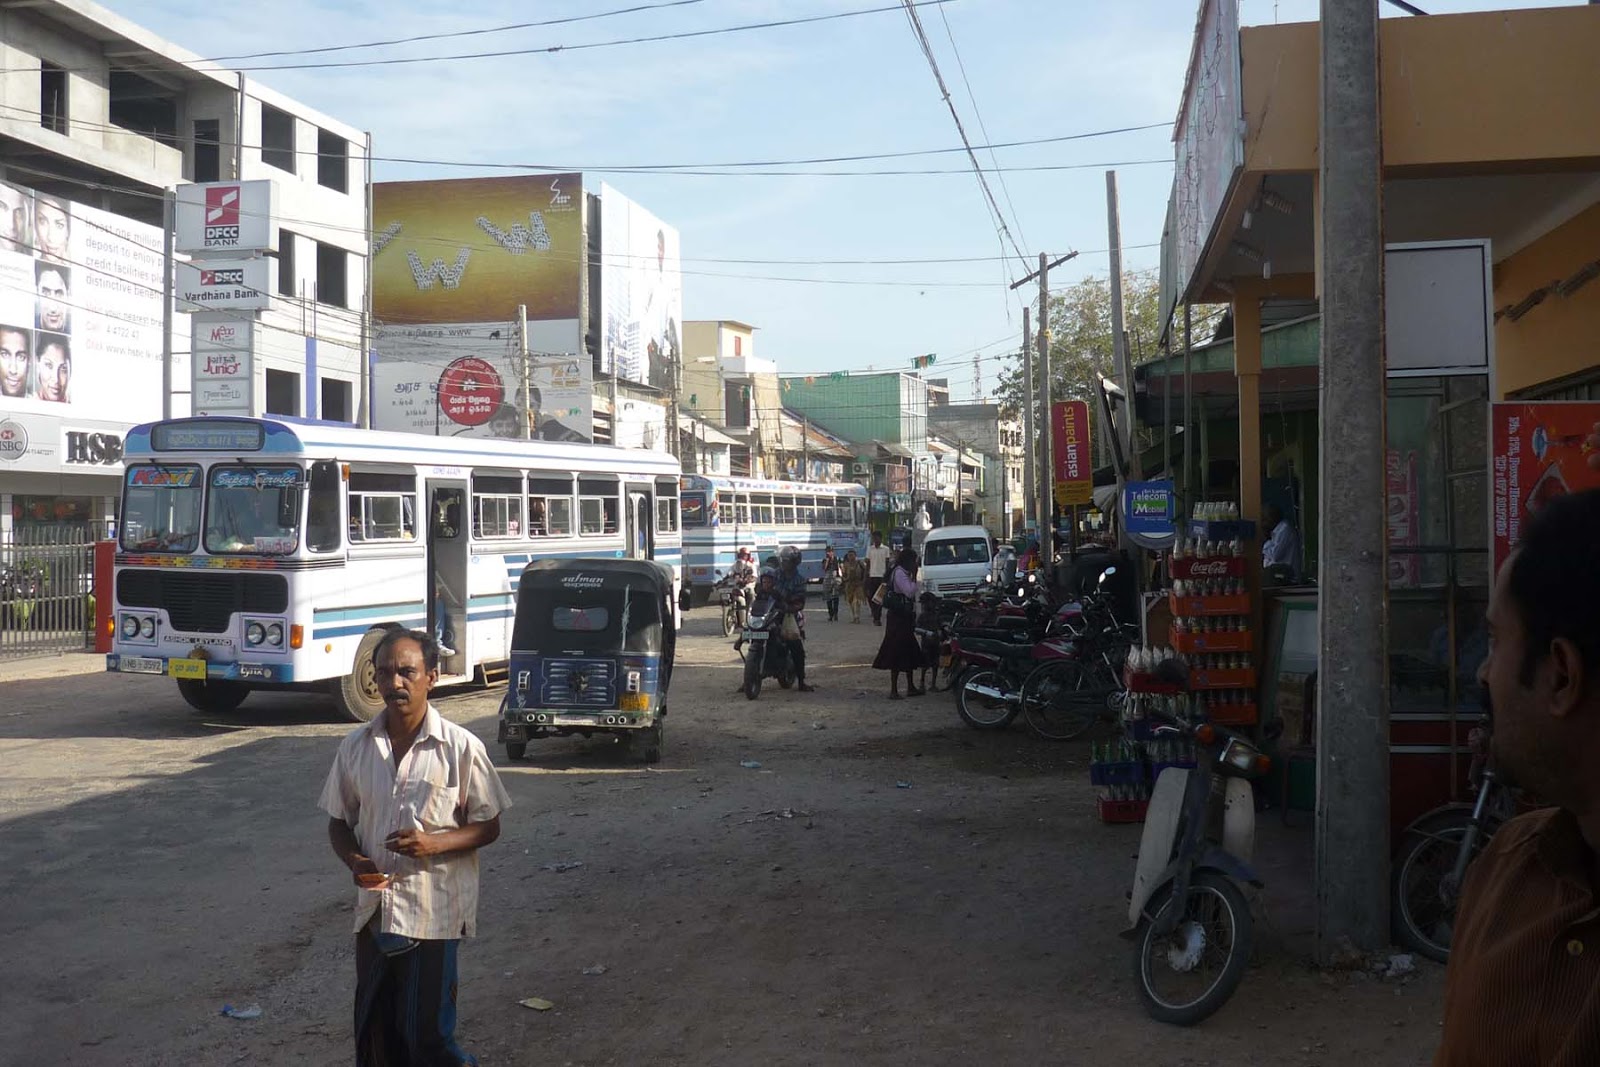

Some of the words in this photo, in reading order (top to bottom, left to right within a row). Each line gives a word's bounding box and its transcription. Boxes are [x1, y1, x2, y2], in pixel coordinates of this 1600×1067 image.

[205, 226, 239, 239] DFCC
[134, 234, 163, 250] million
[204, 238, 239, 247] BANK
[86, 236, 119, 254] deposit
[121, 247, 131, 258] to
[133, 251, 155, 268] enjoy
[86, 257, 111, 272] credit
[114, 260, 150, 282] facilities
[214, 270, 243, 284] DFCC
[86, 275, 132, 294] distinctive
[185, 290, 231, 301] Vardhana
[234, 288, 259, 300] Bank
[203, 356, 242, 375] Junior
[65, 430, 124, 466] HSB
[1062, 406, 1081, 478] asianpaints
[214, 471, 249, 489] Super
[1131, 490, 1168, 501] Telecom
[561, 572, 604, 583] salman
[164, 635, 191, 645] ASHOK
[195, 637, 232, 646] LEYLAND
